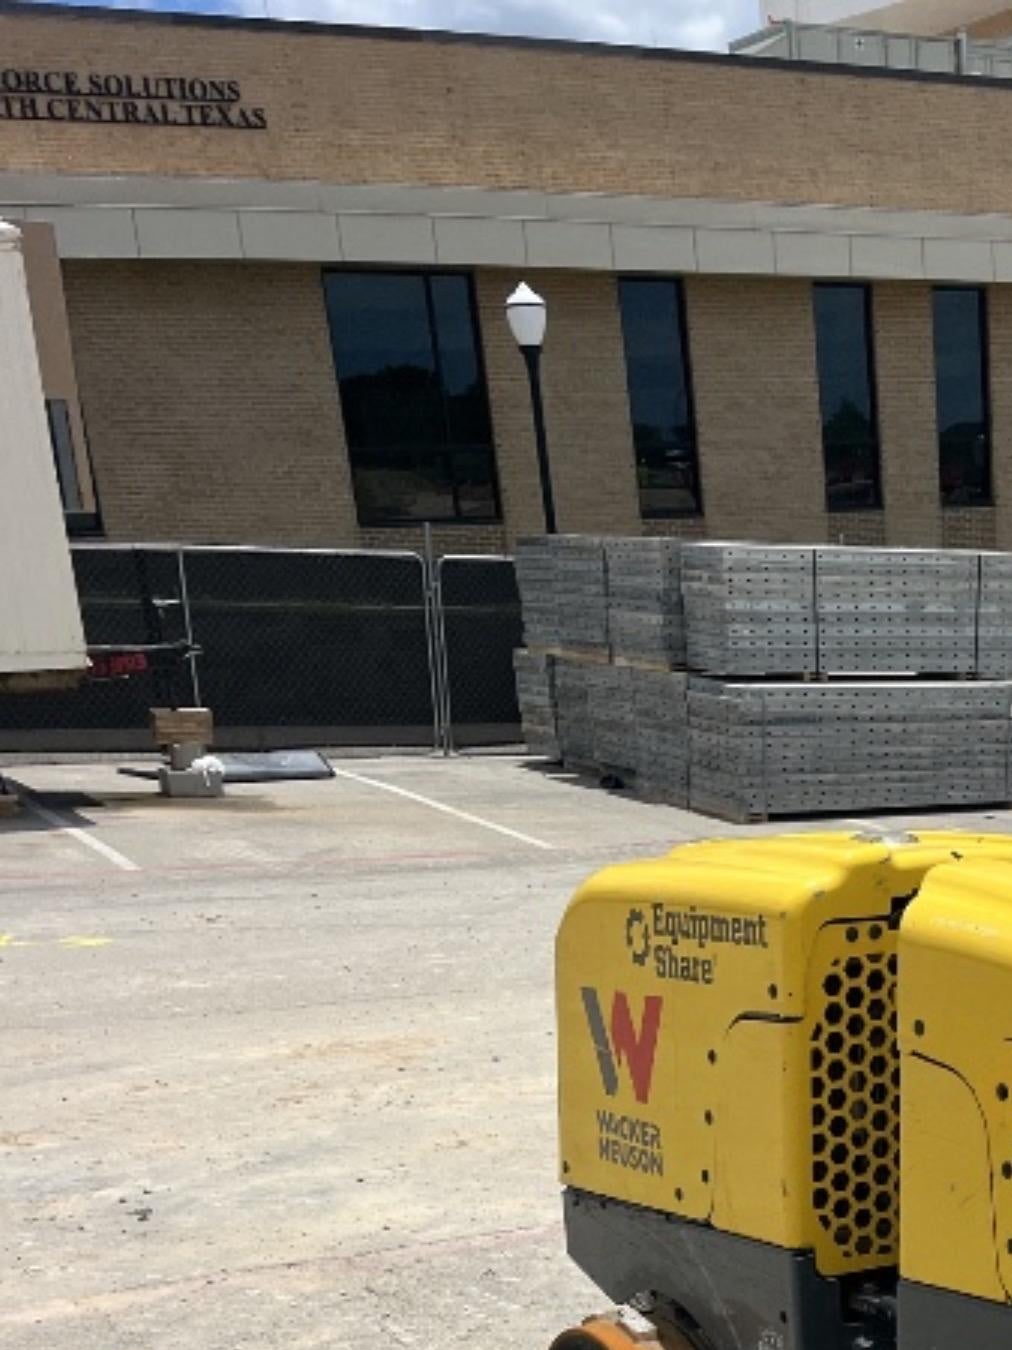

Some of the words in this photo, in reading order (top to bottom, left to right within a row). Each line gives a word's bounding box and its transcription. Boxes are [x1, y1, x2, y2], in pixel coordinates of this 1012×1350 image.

[88, 73, 241, 101] SOLUTIONS
[0, 95, 39, 120] TH
[47, 98, 177, 125] CENTRAL
[180, 104, 267, 129] TEXAS
[652, 903, 769, 949] Equipment
[655, 944, 715, 984] Share
